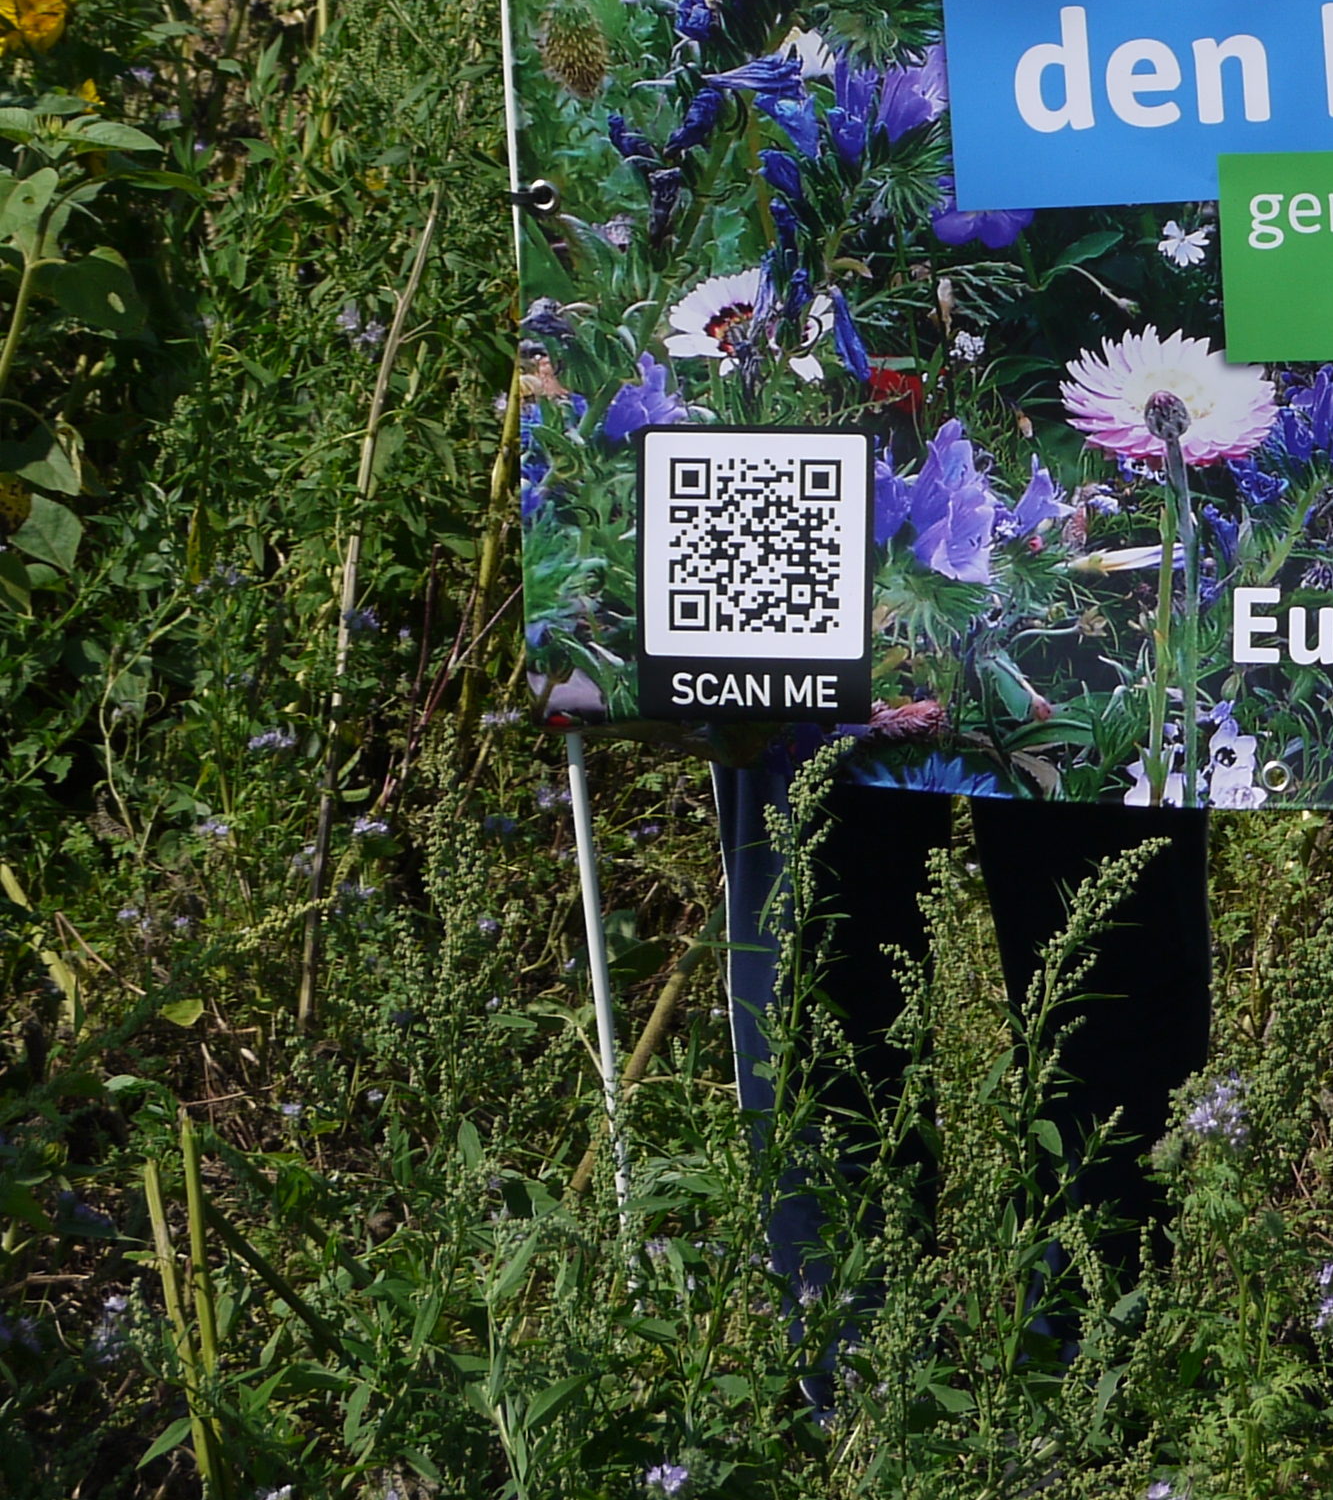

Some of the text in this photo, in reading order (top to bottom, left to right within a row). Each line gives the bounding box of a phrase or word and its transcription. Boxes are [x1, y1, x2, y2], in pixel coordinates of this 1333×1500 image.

[1013, 4, 1271, 134] den
[671, 672, 839, 709] SCAN ME
